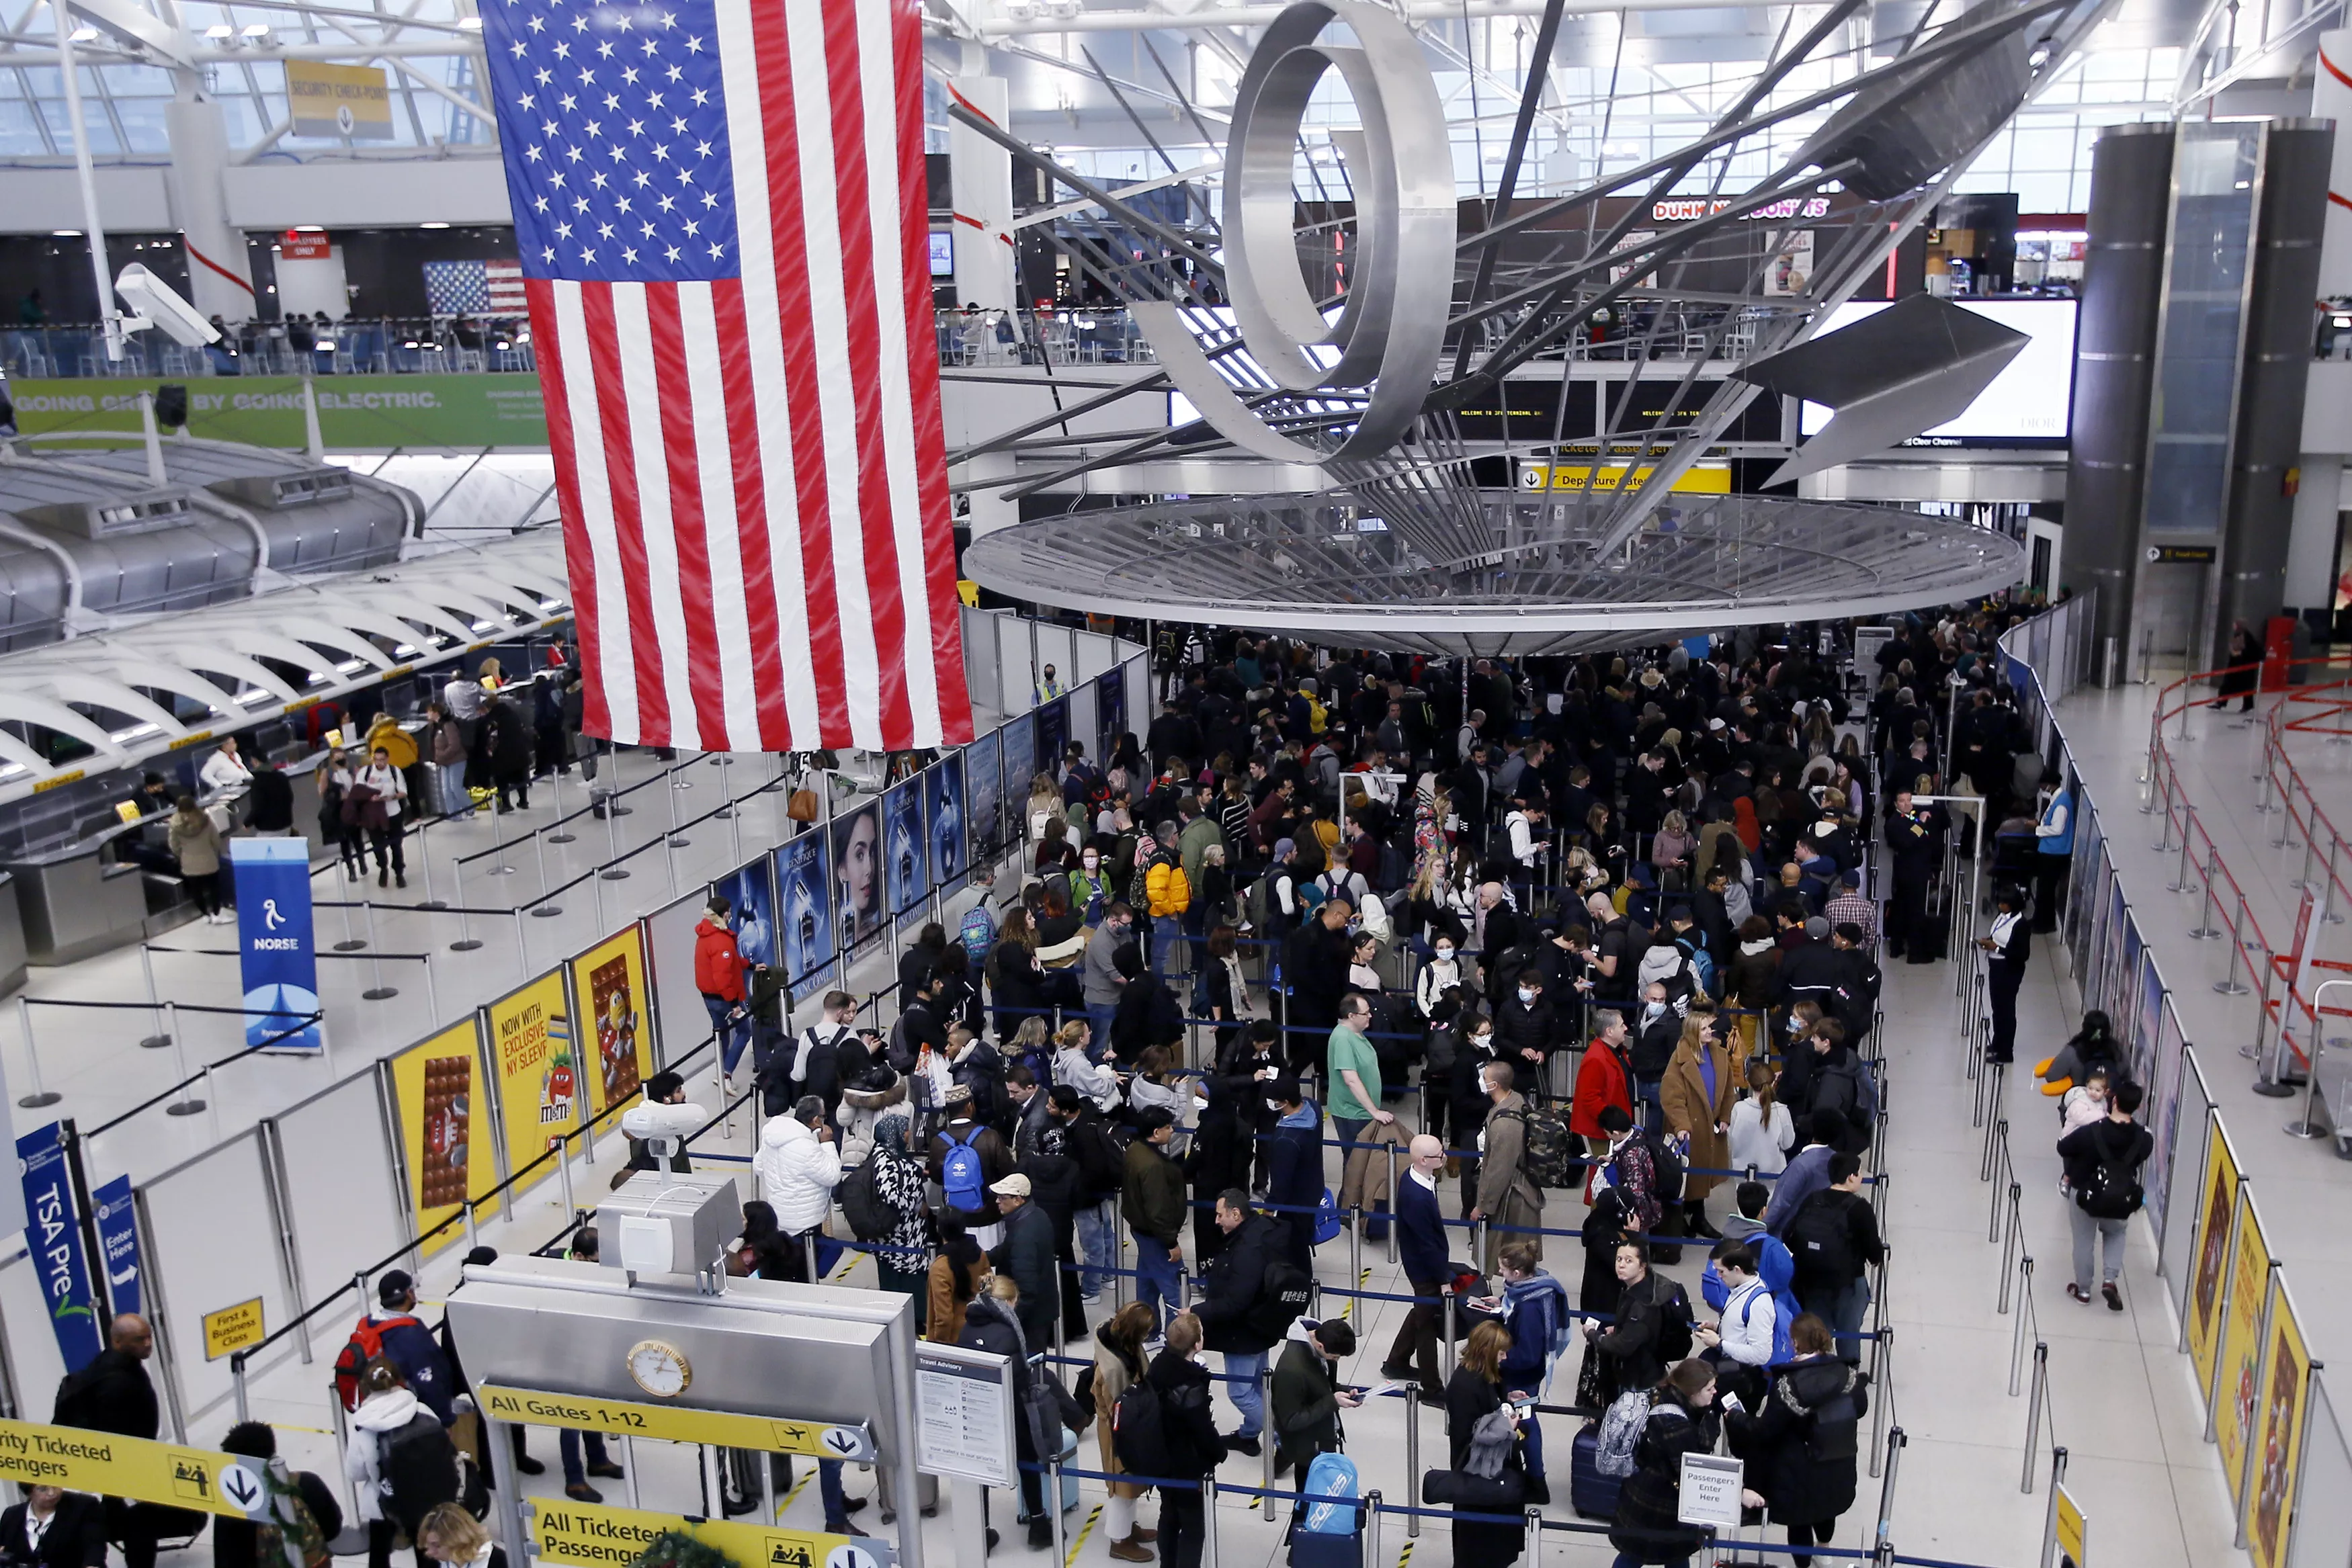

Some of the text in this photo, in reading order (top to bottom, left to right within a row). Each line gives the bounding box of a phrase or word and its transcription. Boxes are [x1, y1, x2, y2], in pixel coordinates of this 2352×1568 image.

[292, 81, 333, 96] SECURITY
[1655, 202, 1728, 217] DUNKN
[294, 246, 315, 256] ONLY
[15, 395, 95, 412] GOING
[192, 394, 225, 410] BY
[233, 392, 306, 409] GOING
[319, 391, 442, 409] ELECTRIC.
[2021, 417, 2056, 429] DIOR
[1913, 437, 1962, 446] Clear Channel
[254, 938, 299, 951] NORSE
[501, 1002, 542, 1038] NOW WITH
[504, 1020, 546, 1058] EXCLUSIVE
[507, 1057, 517, 1078] NY
[36, 1182, 66, 1247] TSA
[105, 1227, 134, 1250] Enter
[109, 1241, 134, 1262] Here
[46, 1244, 73, 1298] Pre
[217, 1309, 249, 1326] First &
[212, 1319, 256, 1340] Business
[222, 1332, 248, 1346] Class
[919, 1357, 962, 1371] Travel Advisory
[492, 1395, 647, 1428] All Gates 1-12
[32, 1435, 112, 1463] Ticketed
[1687, 1473, 1735, 1485] Passengers
[1699, 1483, 1722, 1493] Enter
[1699, 1493, 1720, 1502] Here
[542, 1512, 667, 1543] All Ticketed
[545, 1535, 643, 1567] Passenge
